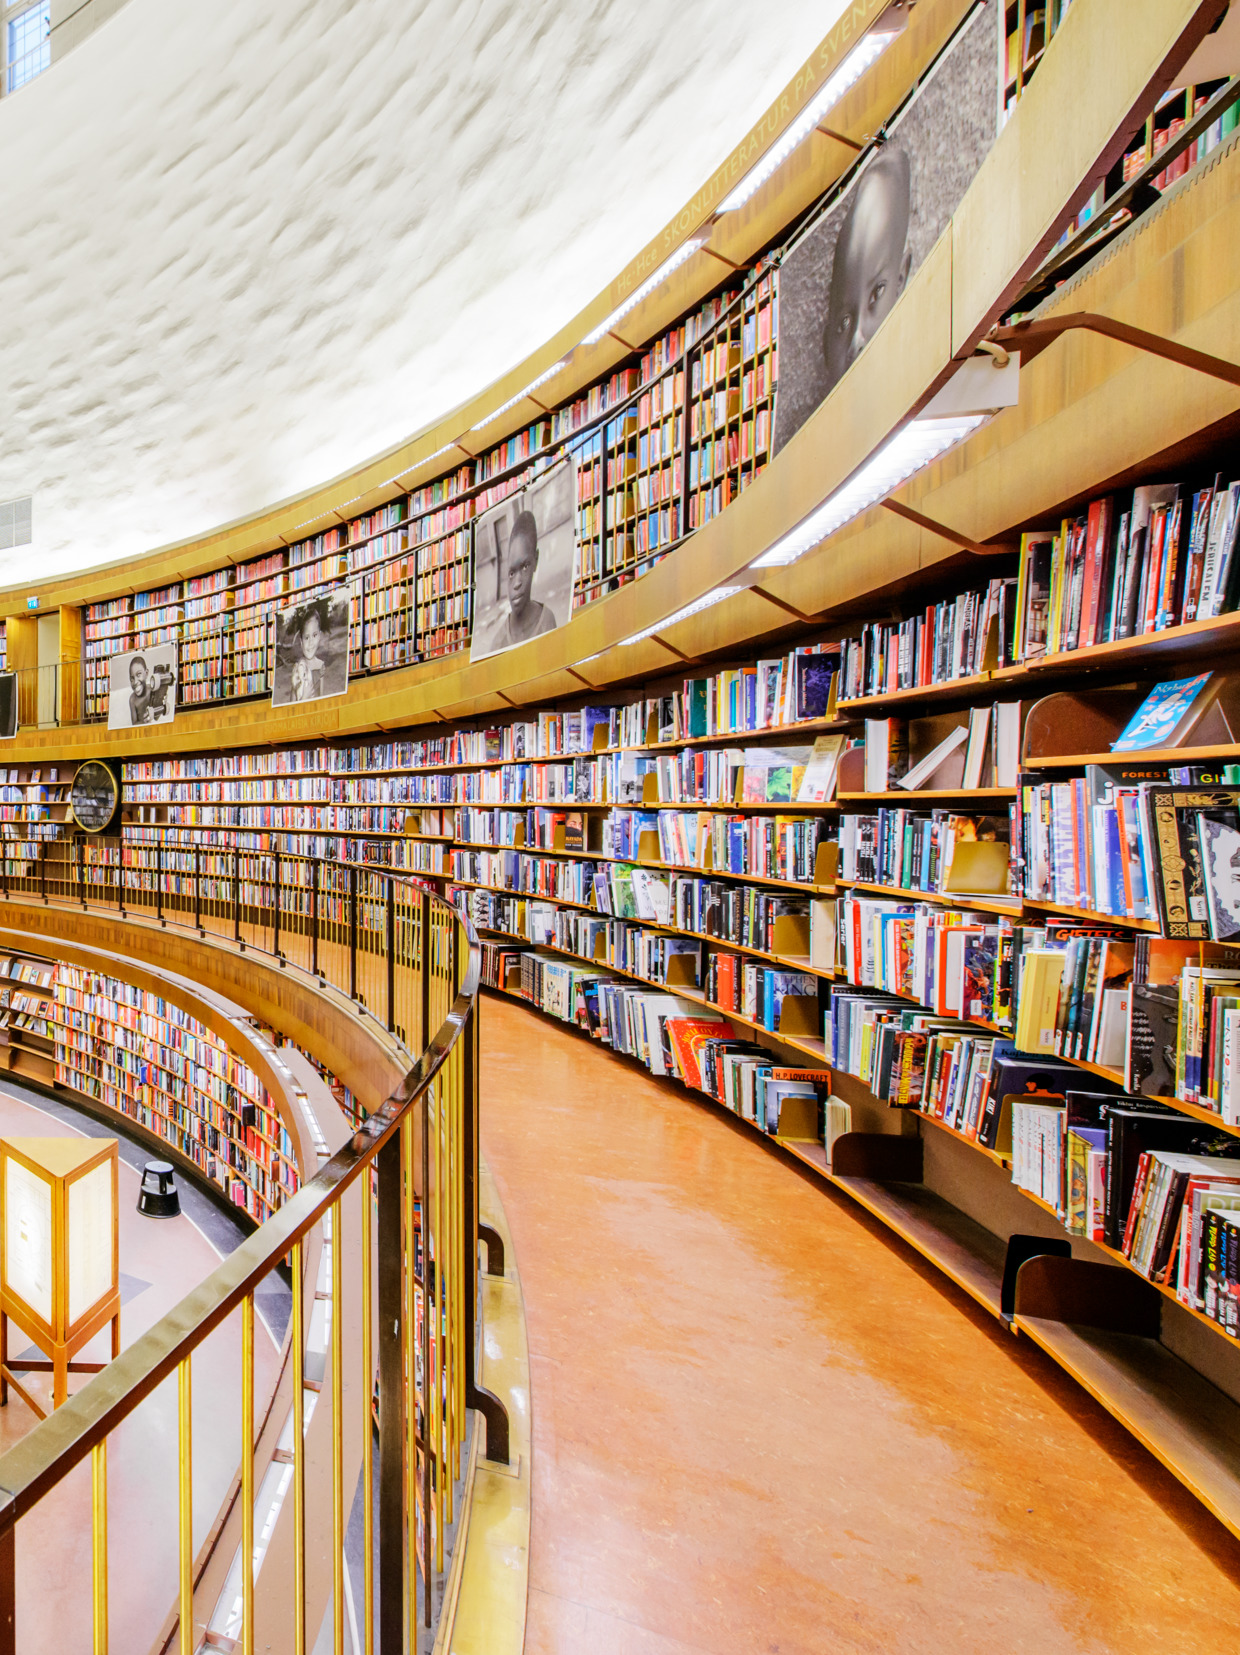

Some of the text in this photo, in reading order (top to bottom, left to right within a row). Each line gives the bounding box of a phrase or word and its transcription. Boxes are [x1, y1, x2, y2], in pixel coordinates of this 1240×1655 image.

[1201, 541, 1216, 601] JERUSALEM
[774, 974, 817, 984] STEPHEN
[774, 983, 817, 997] KING
[790, 1072, 828, 1081] LOVECRAFT
